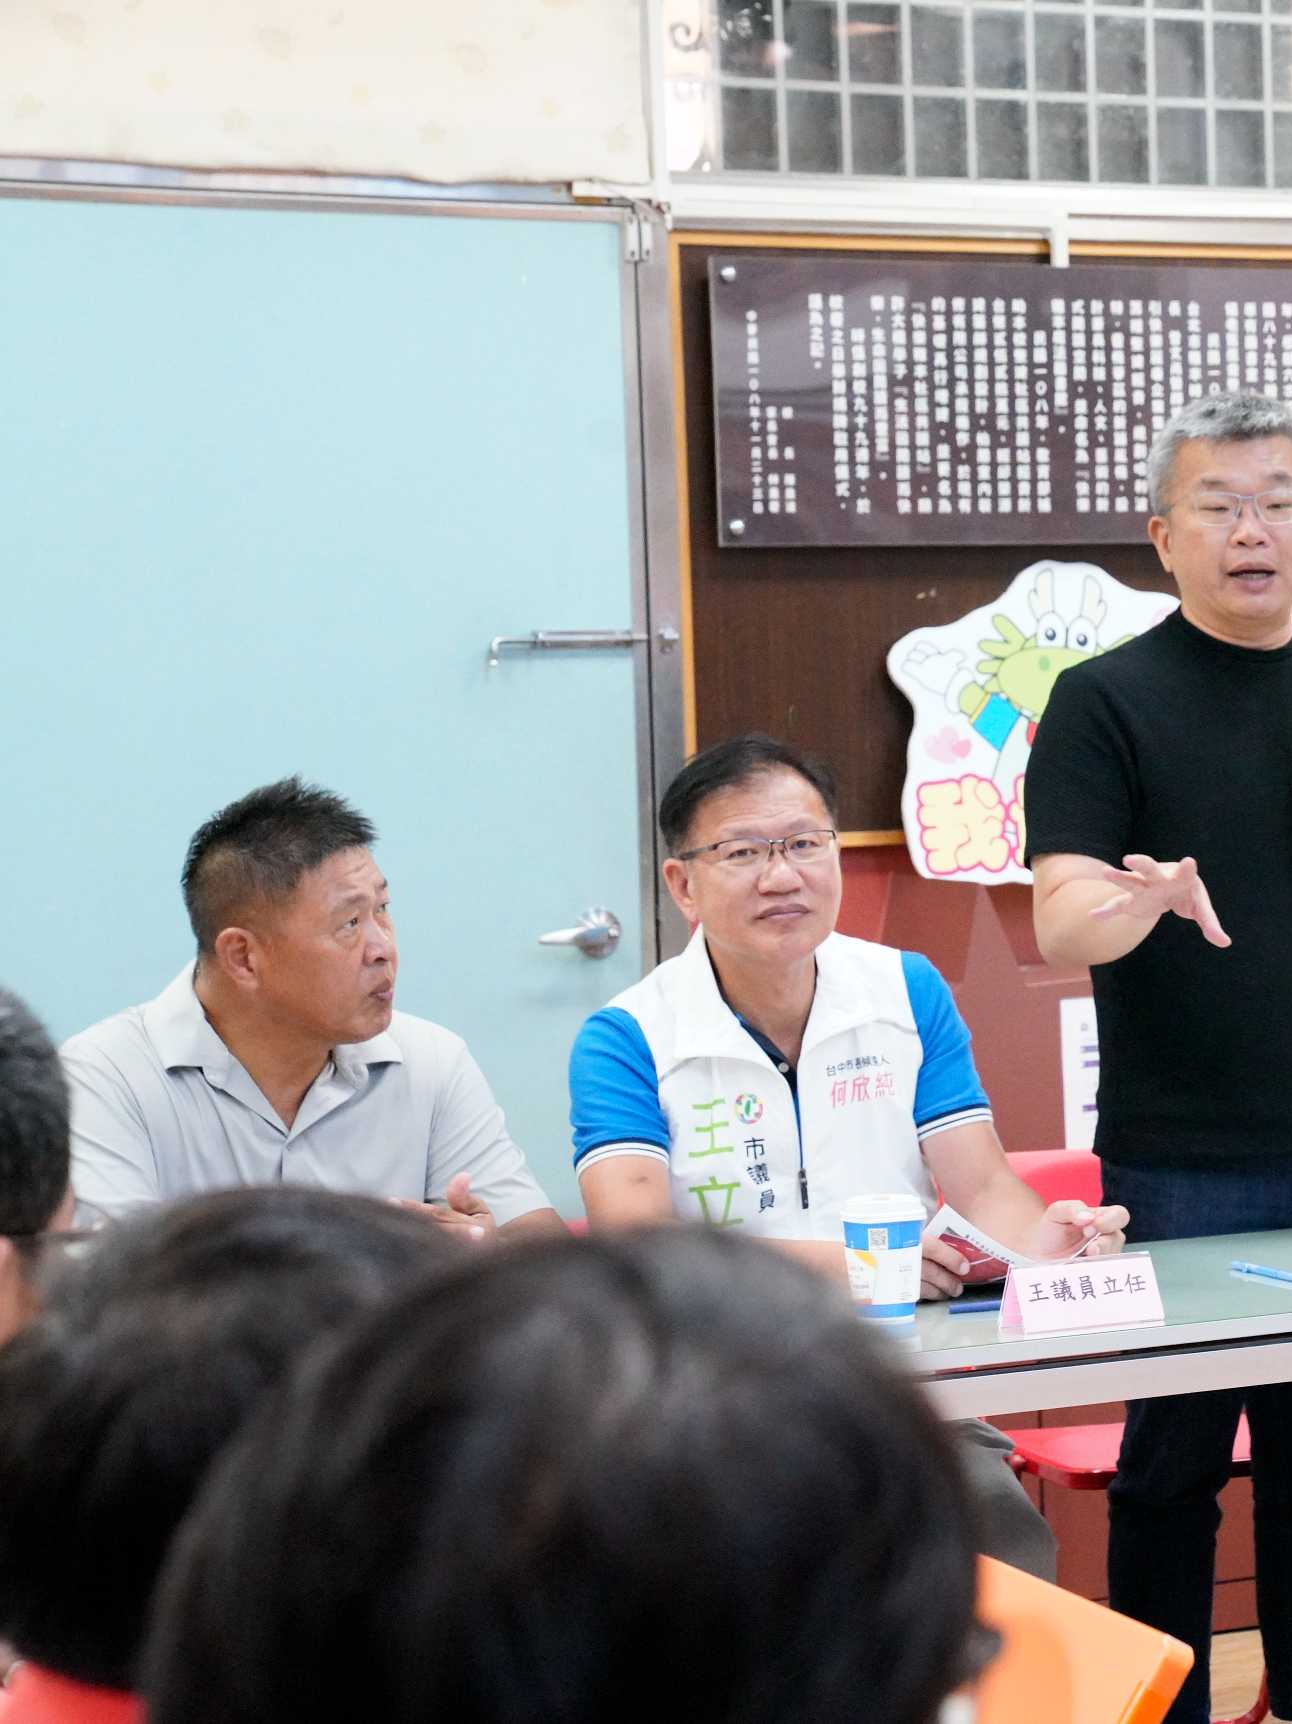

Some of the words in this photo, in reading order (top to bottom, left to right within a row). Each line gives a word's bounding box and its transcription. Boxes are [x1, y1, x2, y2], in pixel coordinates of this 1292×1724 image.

[830, 1073, 896, 1108] 何欣純
[743, 1137, 776, 1213] 市議員
[1028, 1273, 1147, 1303] 王議員立任
